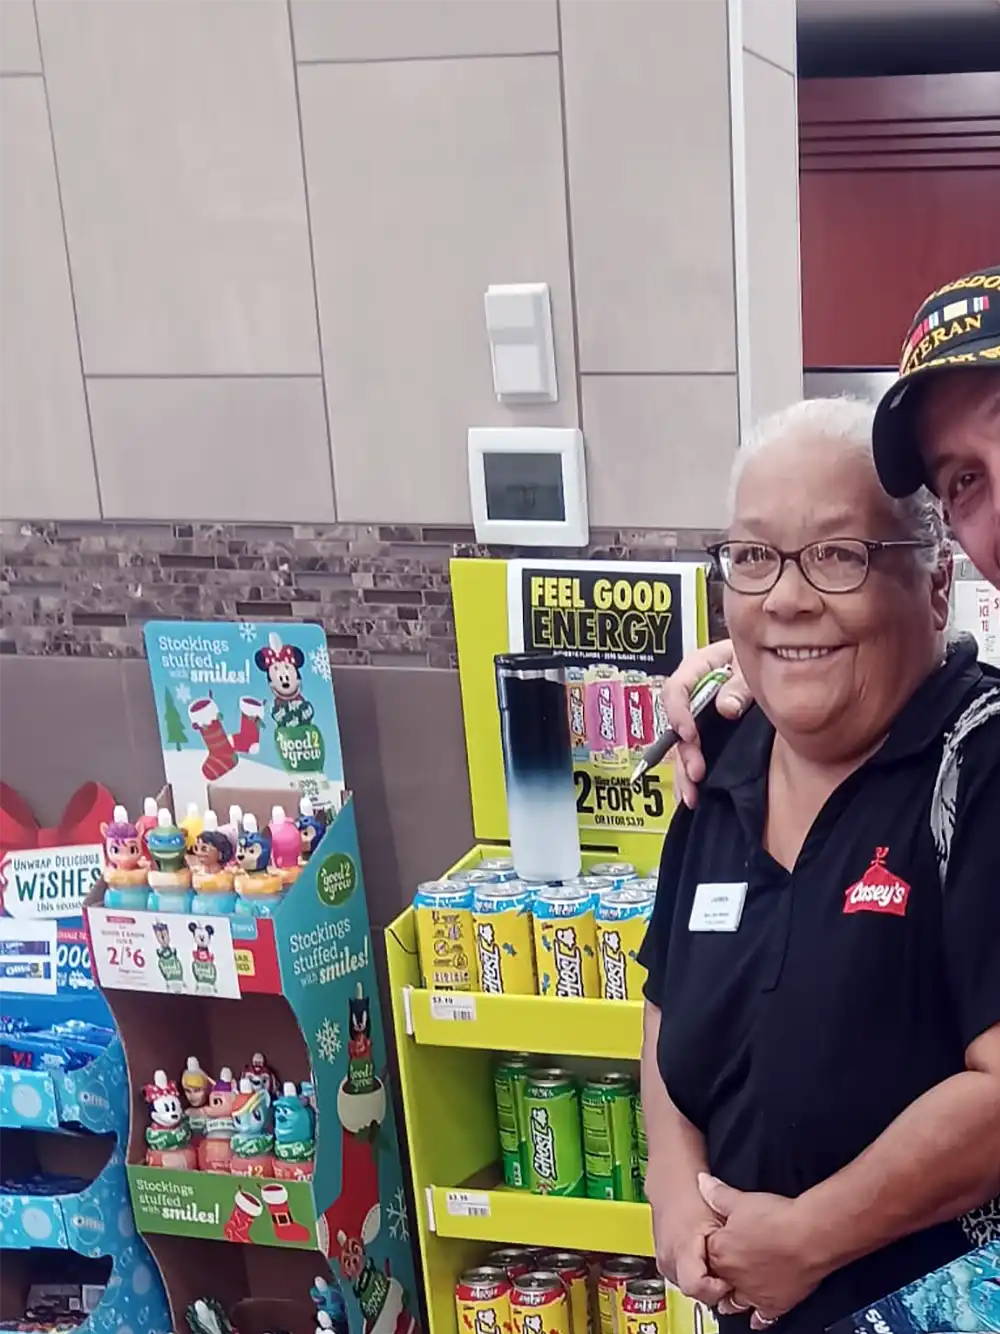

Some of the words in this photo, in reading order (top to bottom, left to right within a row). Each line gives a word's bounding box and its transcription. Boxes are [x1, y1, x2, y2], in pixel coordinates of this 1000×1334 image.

[905, 314, 981, 376] TERAN
[531, 576, 586, 608] FEEL
[593, 578, 672, 612] GOOD
[158, 635, 229, 654] Stockings
[532, 607, 672, 655] ENERGY
[162, 653, 213, 669] stuffed
[190, 659, 250, 684] smiles!
[574, 771, 594, 814] 2
[596, 786, 635, 812] FOR
[13, 859, 52, 871] UNWRAP
[55, 853, 100, 868] DELICIOUS
[37, 902, 54, 912] this
[850, 881, 905, 908] Casey's
[290, 918, 351, 953] Stockings
[293, 941, 338, 976] stuffed
[319, 935, 369, 985] smiles!
[531, 1113, 558, 1181] GHOST
[136, 1179, 194, 1196] Stockings
[139, 1193, 182, 1207] stuffed
[142, 1205, 160, 1213] with
[162, 1203, 220, 1224] smiles!
